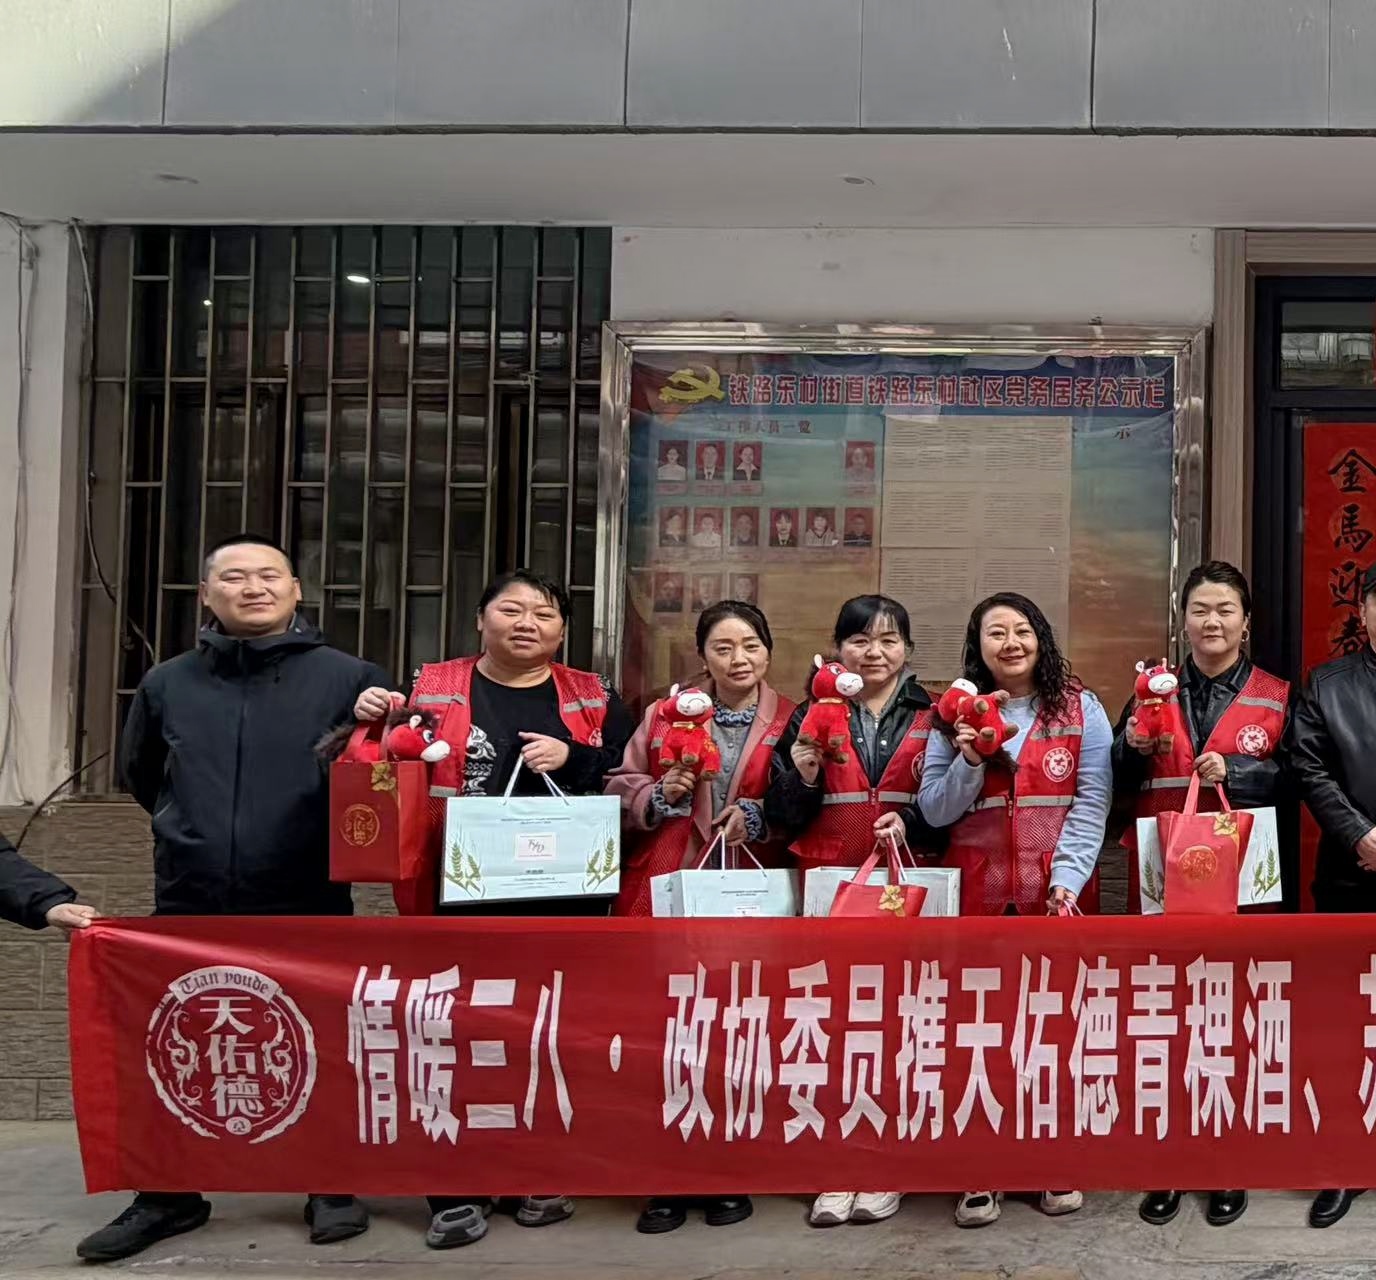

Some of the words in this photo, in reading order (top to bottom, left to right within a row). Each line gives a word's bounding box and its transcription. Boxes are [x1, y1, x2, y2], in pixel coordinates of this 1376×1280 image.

[178, 971, 219, 995] Tian
[224, 971, 269, 994] youde
[200, 996, 266, 1118] 天佑德
